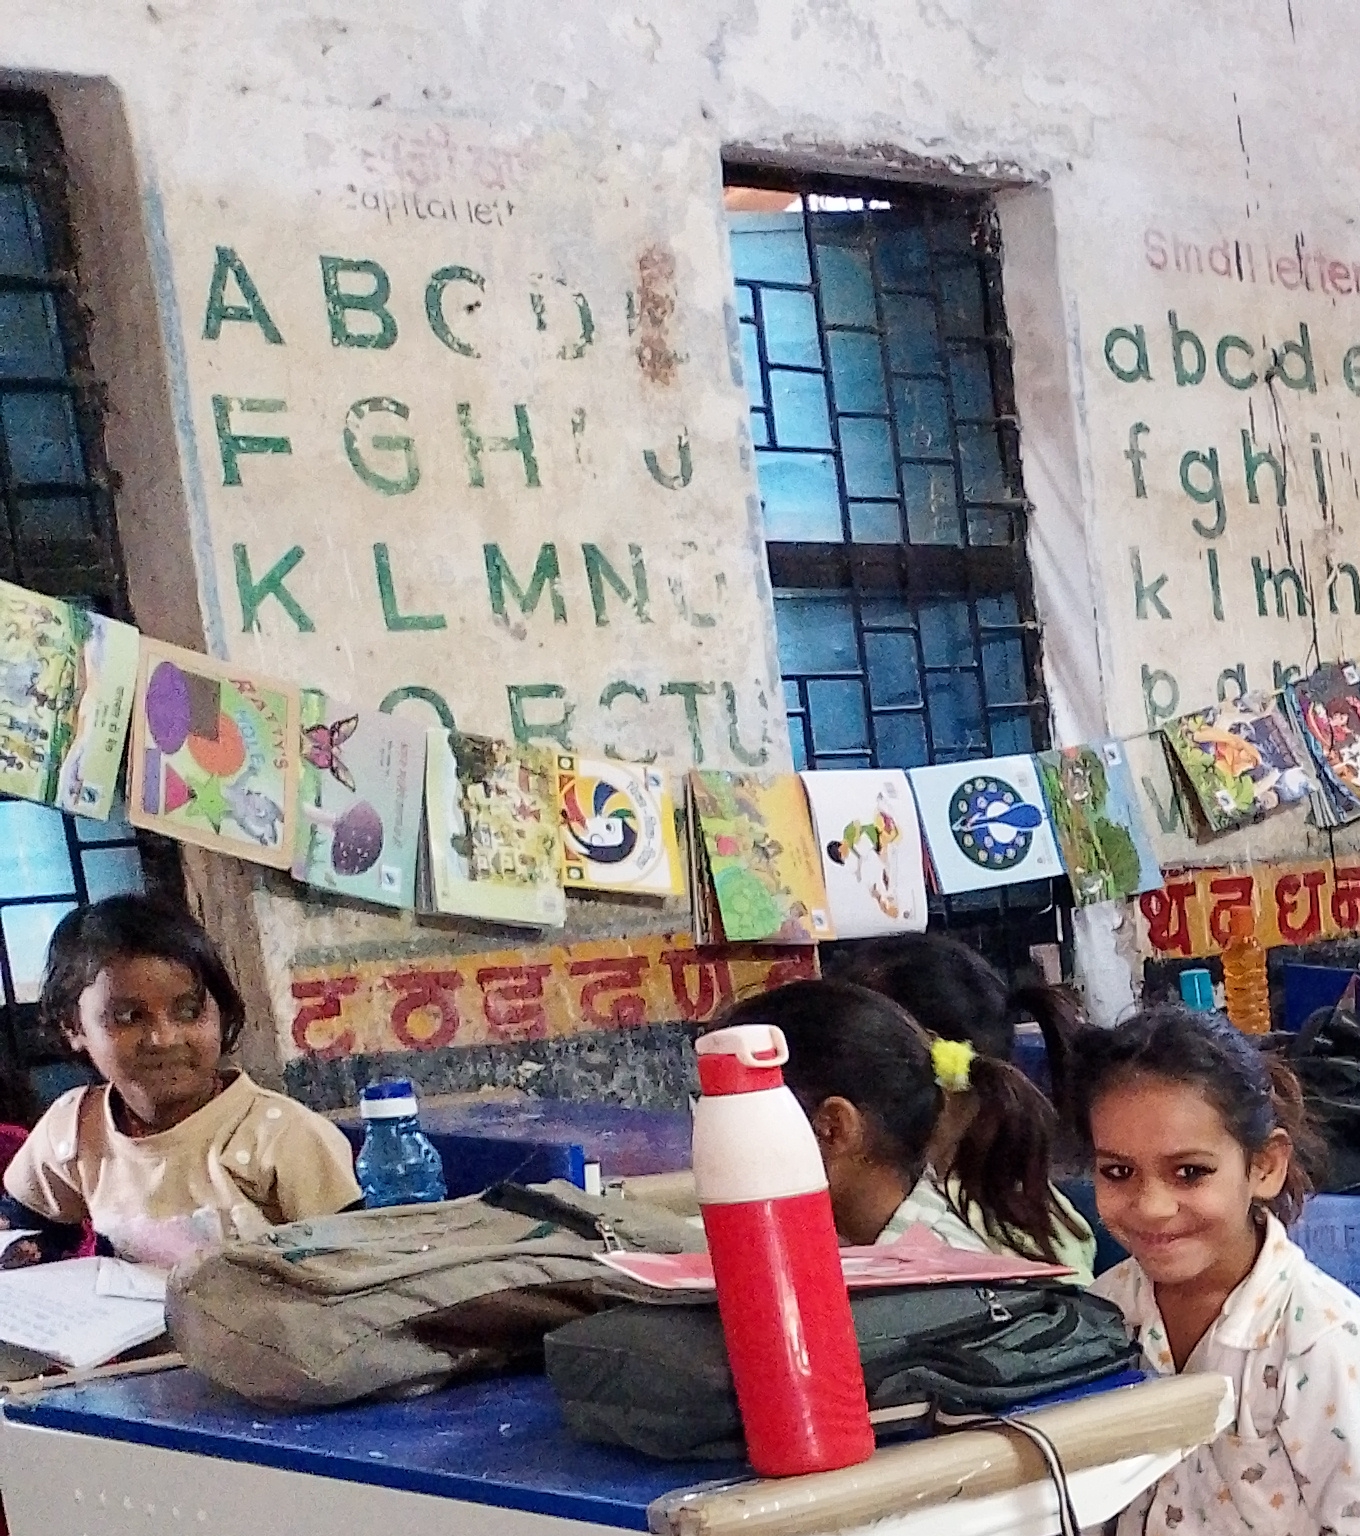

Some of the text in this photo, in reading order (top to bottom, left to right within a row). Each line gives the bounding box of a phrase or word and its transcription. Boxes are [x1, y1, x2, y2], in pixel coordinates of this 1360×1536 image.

[202, 246, 285, 345] A
[320, 254, 399, 351] B
[424, 265, 487, 360] C
[1104, 324, 1153, 383] a
[1168, 310, 1206, 386] b
[1216, 335, 1258, 390] c
[1274, 322, 1318, 394] d
[211, 394, 292, 487] F
[342, 396, 421, 495] G
[457, 402, 541, 488] H
[1124, 422, 1150, 498] f
[1180, 447, 1226, 539] g
[1241, 429, 1286, 507] h
[232, 543, 314, 633] K
[373, 541, 447, 631] L
[483, 543, 566, 626] M
[582, 543, 648, 626] N
[1130, 546, 1172, 620] k
[1252, 556, 1308, 617] m
[660, 681, 716, 764] T
